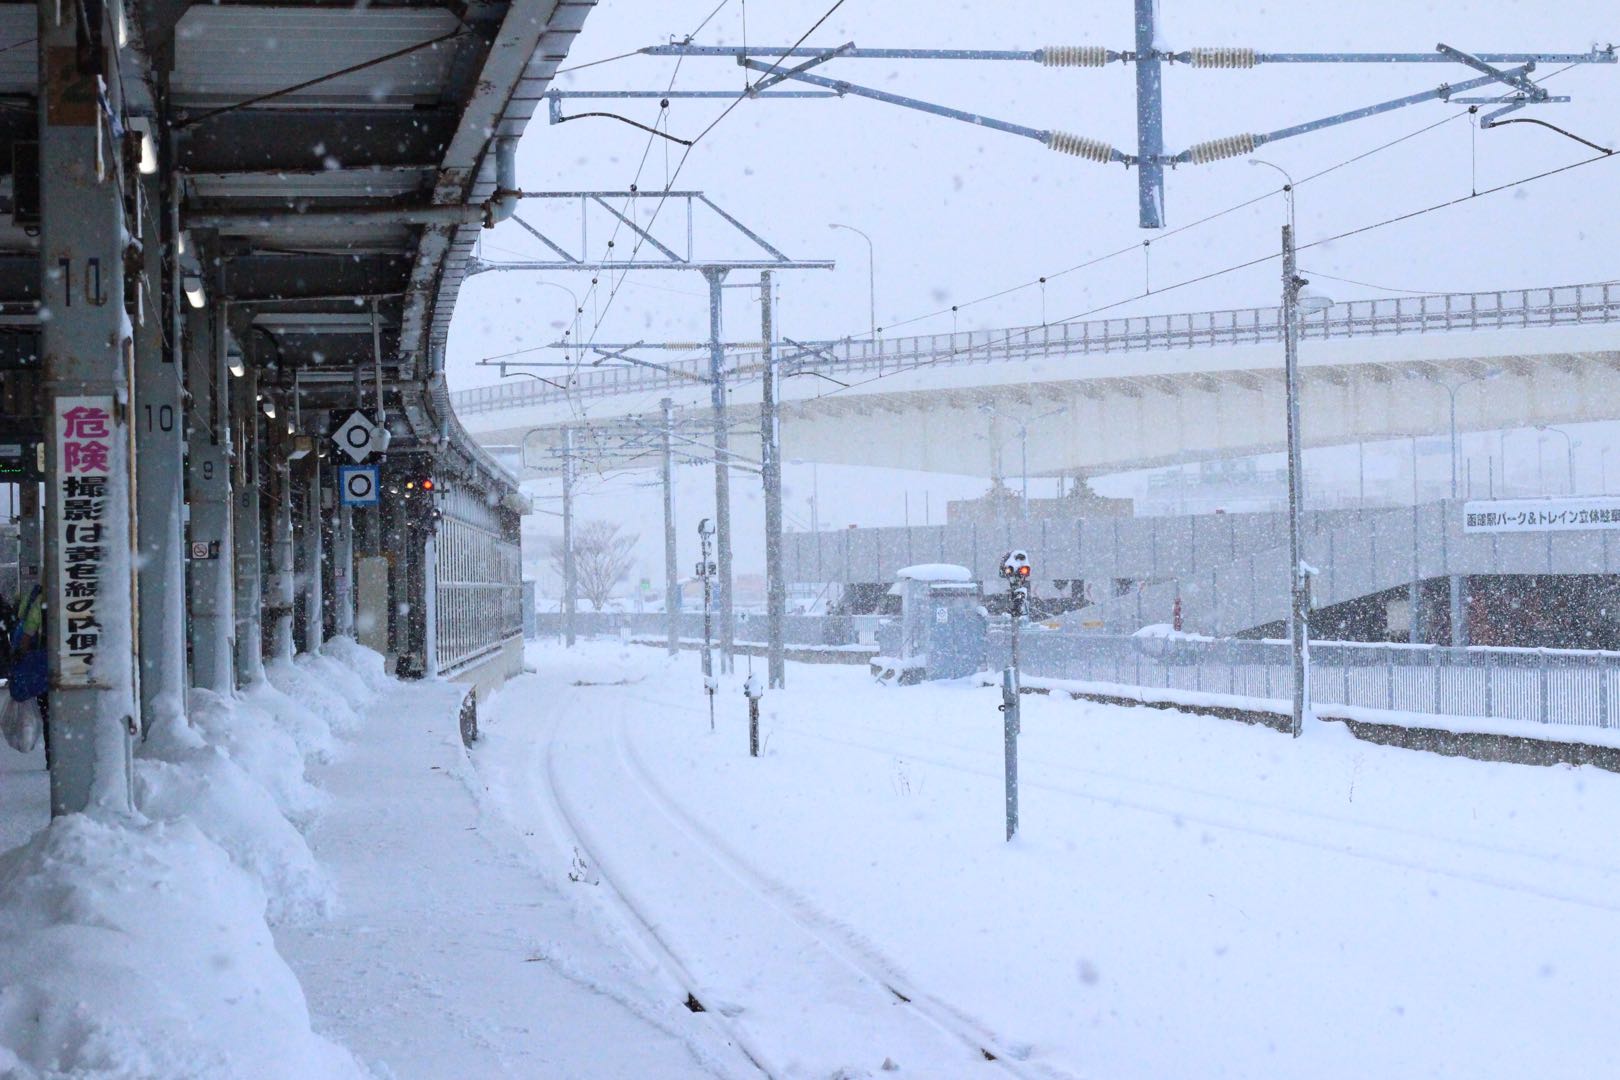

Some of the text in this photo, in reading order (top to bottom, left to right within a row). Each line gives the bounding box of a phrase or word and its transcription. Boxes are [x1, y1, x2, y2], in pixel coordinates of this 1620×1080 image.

[144, 404, 174, 433] 10
[62, 405, 110, 473] 危険
[203, 460, 213, 480] 9
[242, 492, 250, 508] 8
